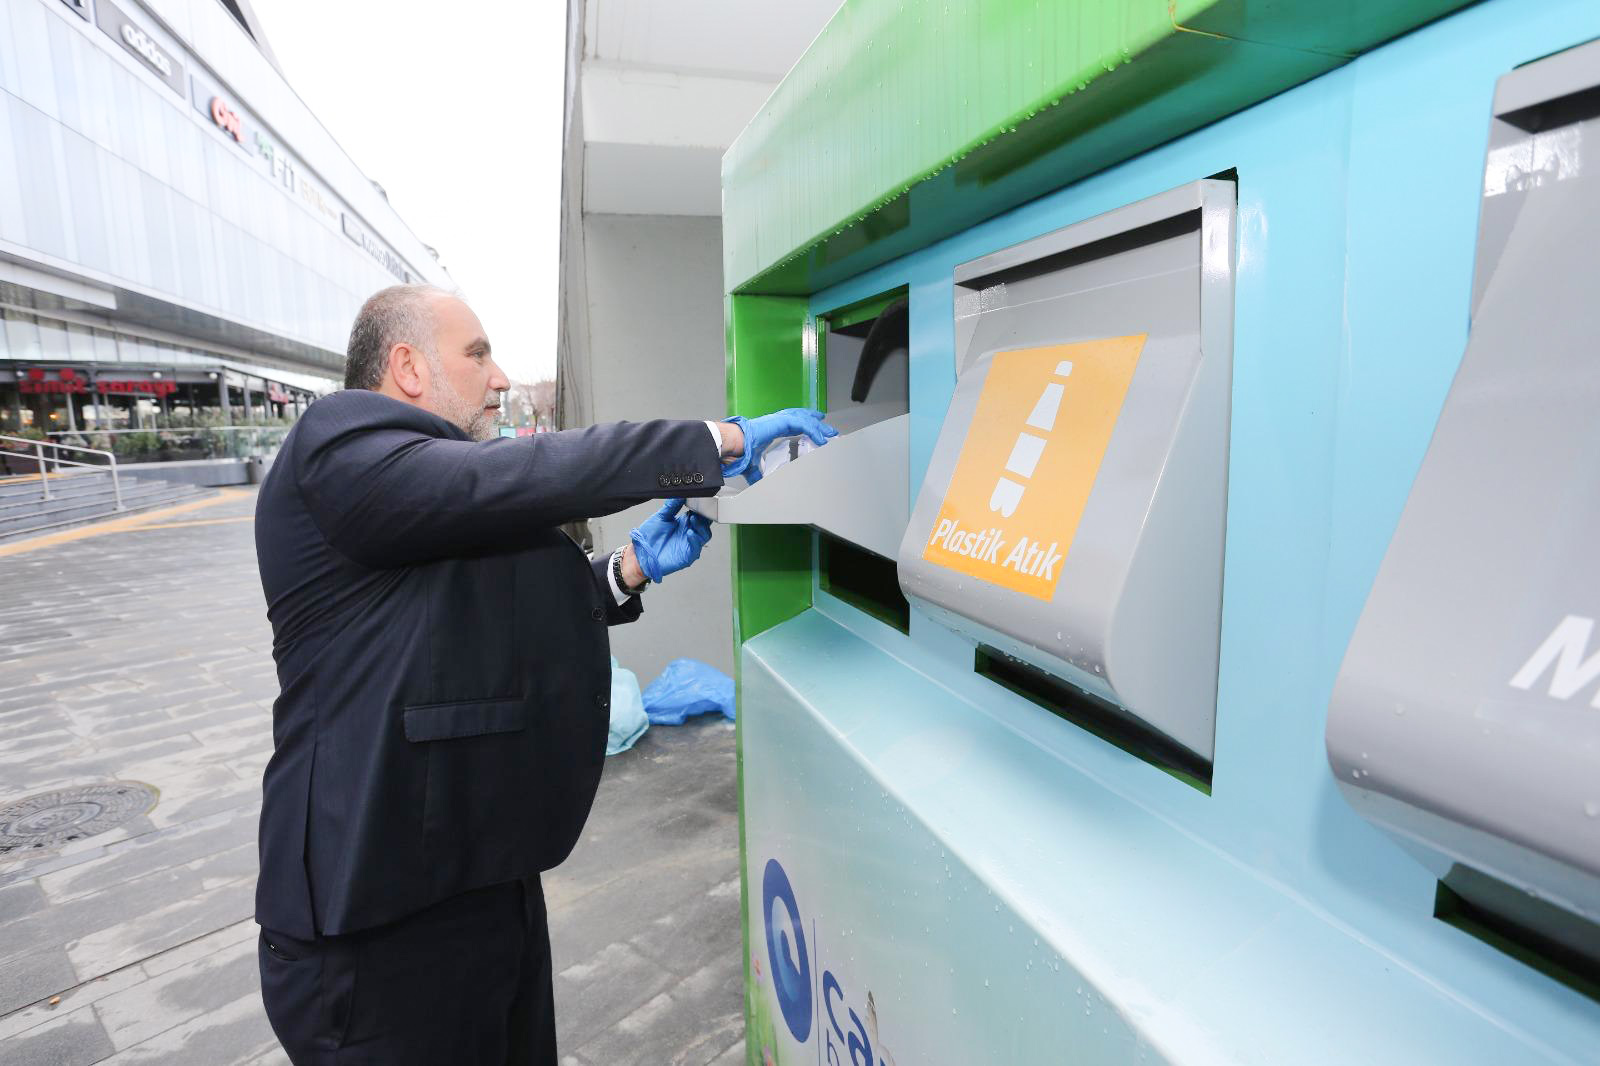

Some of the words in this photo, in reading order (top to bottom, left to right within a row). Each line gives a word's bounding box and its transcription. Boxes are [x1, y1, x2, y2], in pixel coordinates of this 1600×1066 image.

[121, 23, 171, 76] adidas
[930, 518, 1006, 564] Plastik
[1001, 536, 1063, 580] Atık
